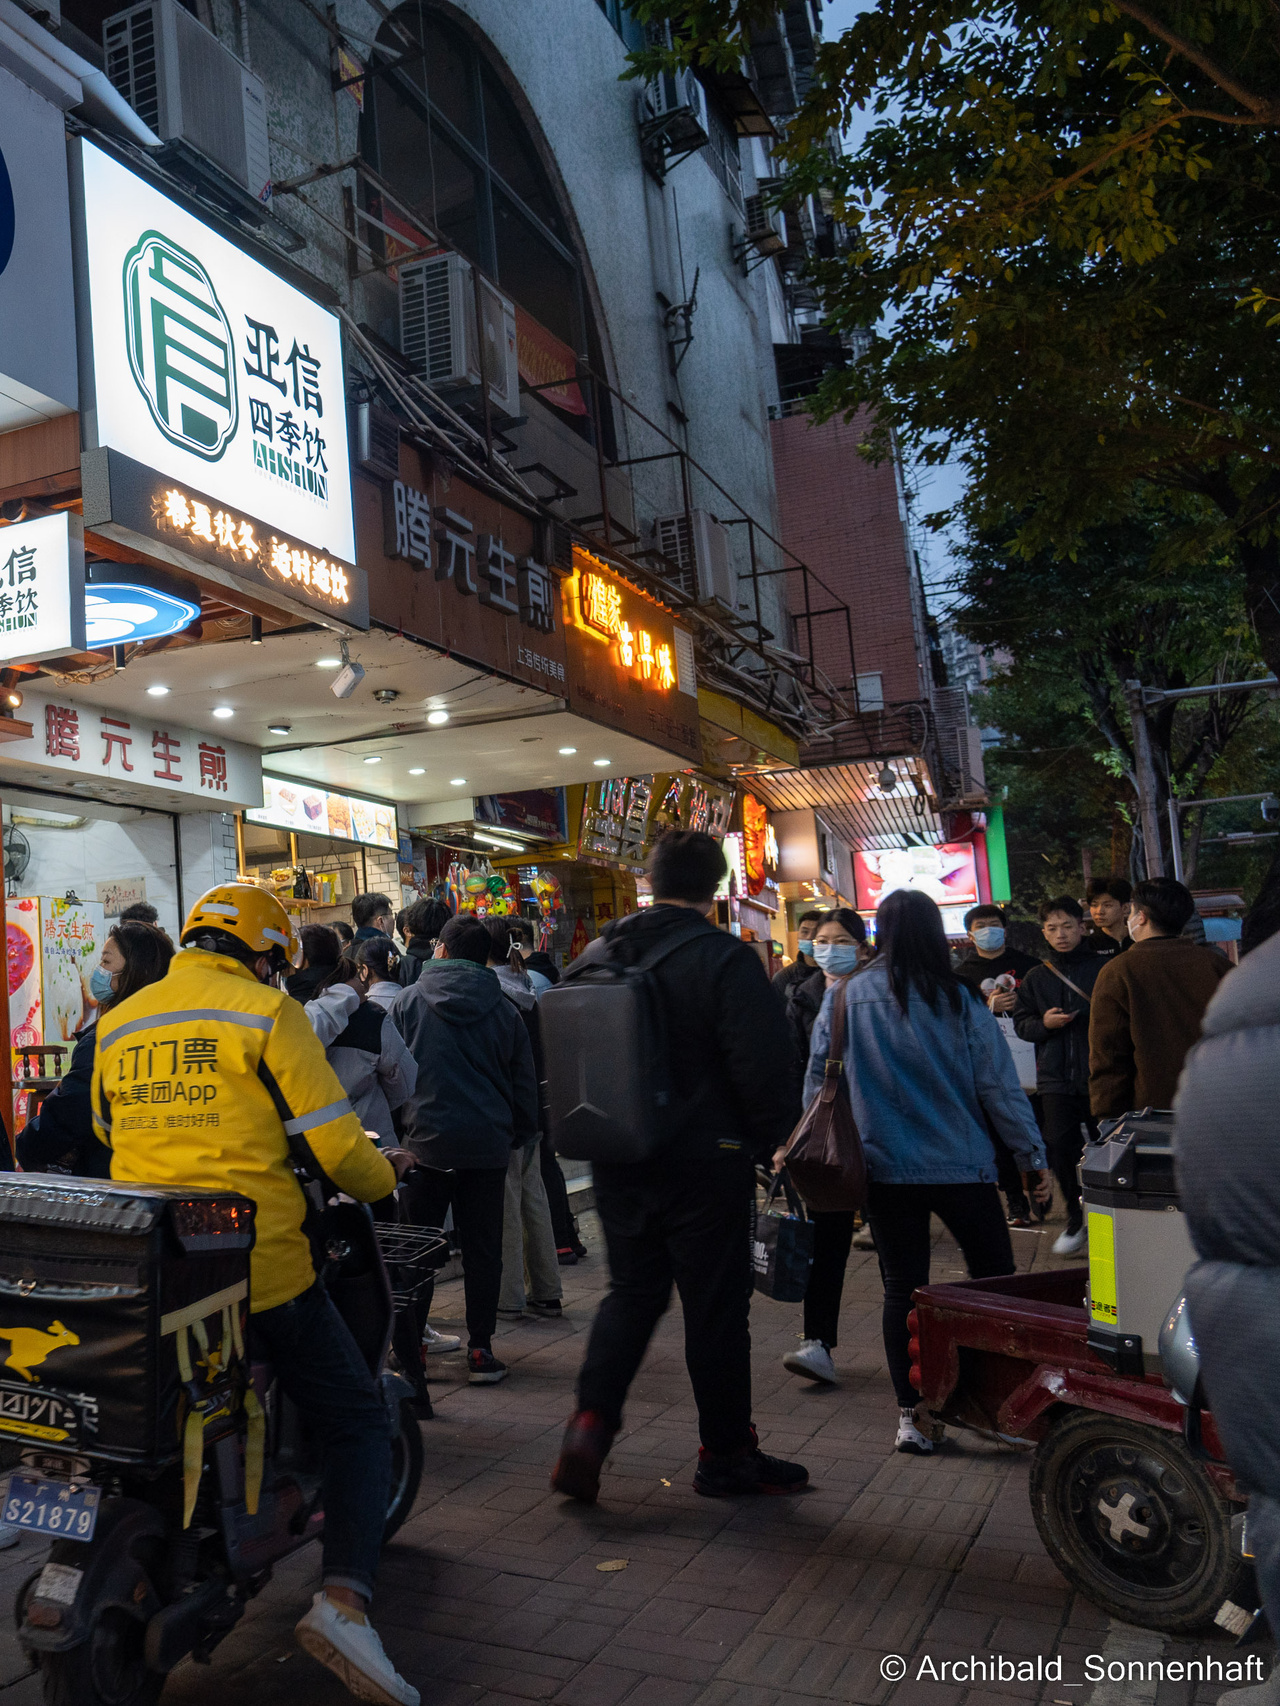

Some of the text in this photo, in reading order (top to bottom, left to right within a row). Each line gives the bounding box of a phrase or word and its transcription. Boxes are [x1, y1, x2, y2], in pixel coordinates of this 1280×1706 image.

[243, 313, 323, 418] 亚信
[248, 394, 329, 473] 四季饮
[164, 489, 260, 561] 春夏秋冬
[391, 479, 556, 635] 腾元生煎
[516, 643, 566, 683] 上海传统美食
[45, 703, 229, 794] 腾元生煎
[43, 918, 95, 941] 腾元生煎
[118, 1037, 219, 1081] 订门票
[163, 1112, 220, 1129] 准时好用
[5, 1497, 92, 1535] S21879
